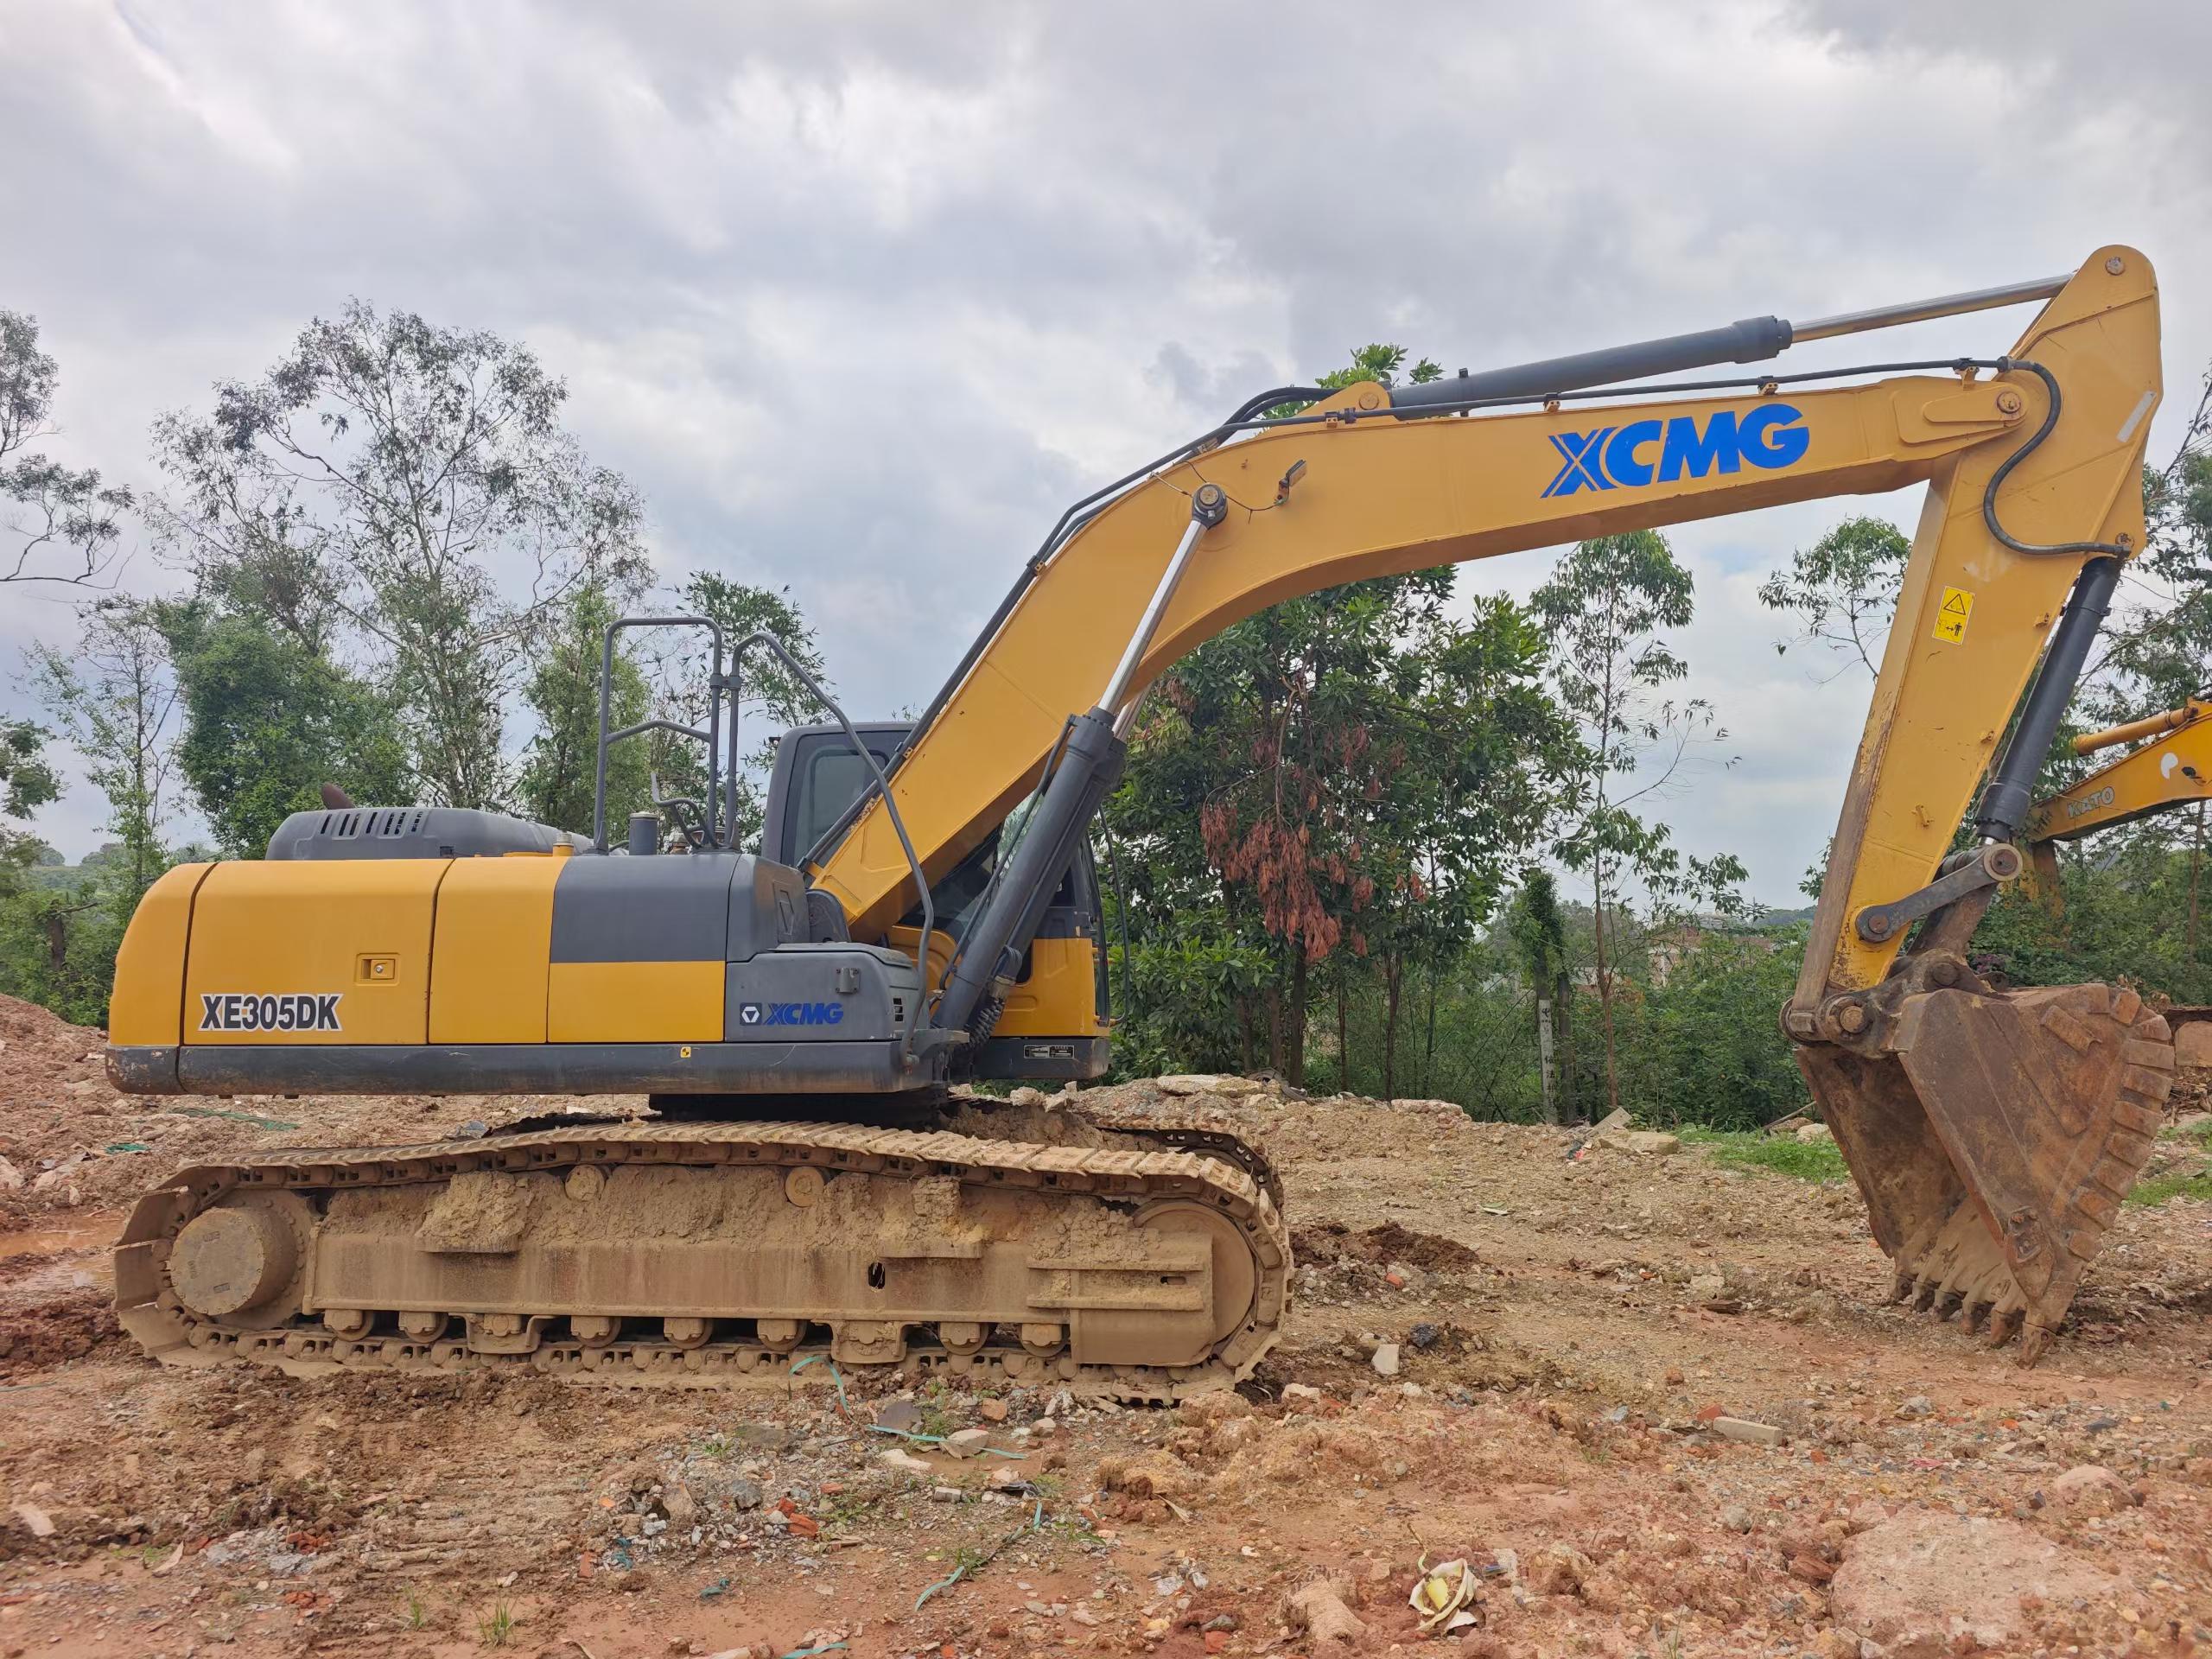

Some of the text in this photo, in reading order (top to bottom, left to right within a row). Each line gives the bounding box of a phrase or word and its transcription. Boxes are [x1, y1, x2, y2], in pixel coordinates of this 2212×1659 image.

[1540, 404, 1809, 499] XCMG
[2068, 785, 2115, 818] KATO
[200, 995, 342, 1031] XE305DK
[764, 1002, 844, 1026] XCMG
